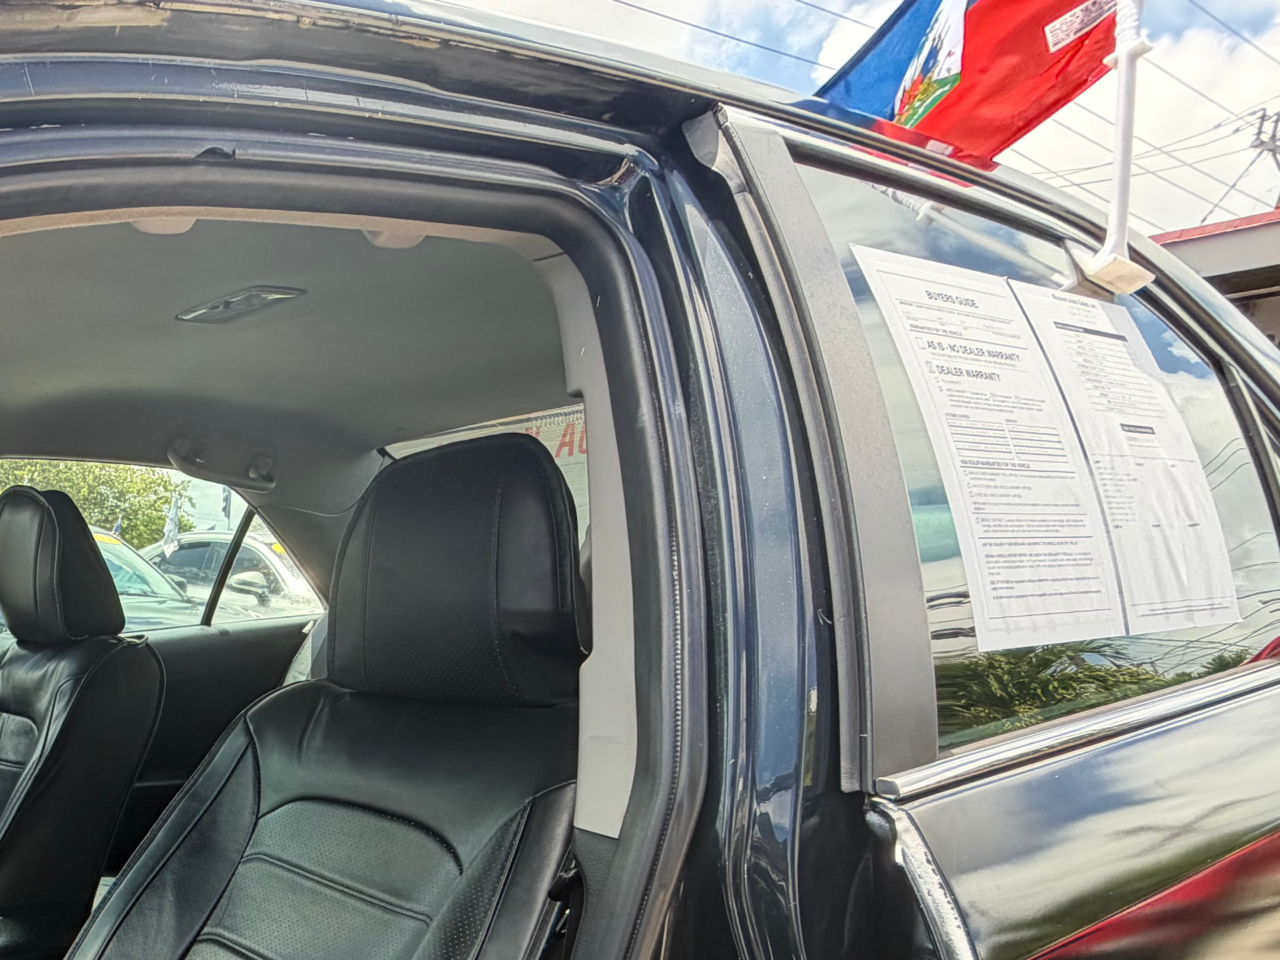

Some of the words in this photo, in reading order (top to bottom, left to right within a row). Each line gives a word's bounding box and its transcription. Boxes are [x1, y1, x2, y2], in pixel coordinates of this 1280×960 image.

[927, 340, 937, 350] AS
[937, 342, 945, 351] IS
[948, 343, 960, 354] NO
[959, 345, 986, 358] DEALER
[986, 349, 1021, 362] WARRANTY
[936, 365, 965, 378] DEALER
[965, 369, 1001, 382] WARRANTY
